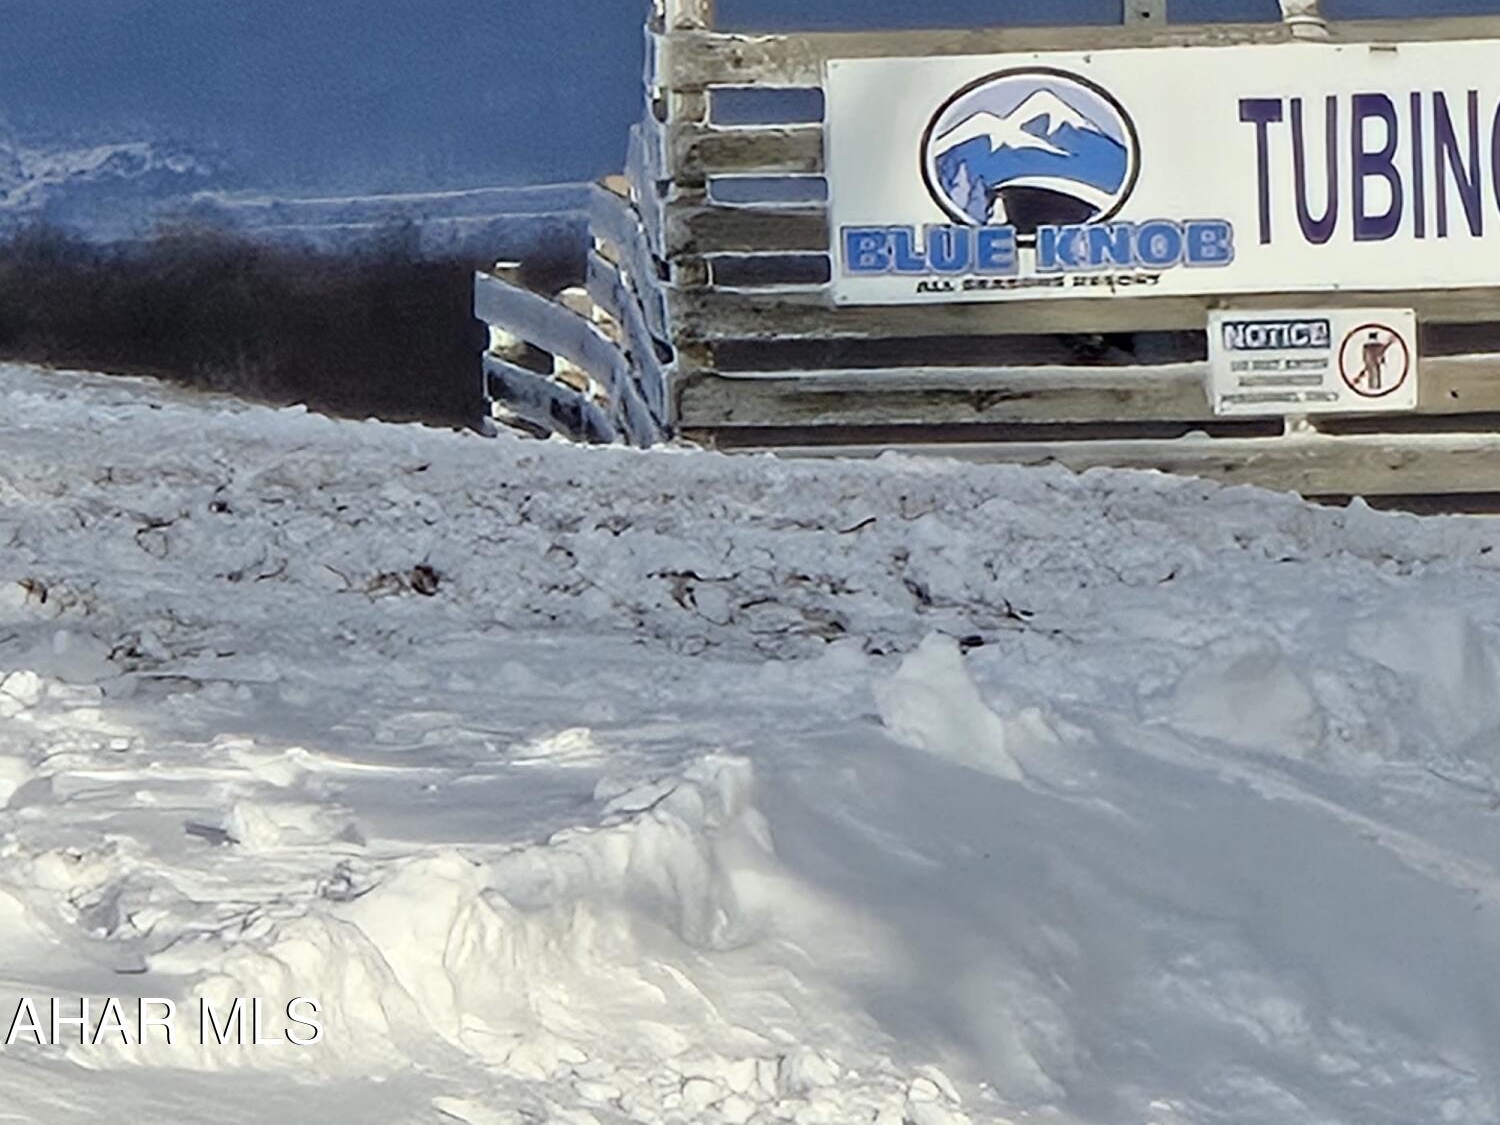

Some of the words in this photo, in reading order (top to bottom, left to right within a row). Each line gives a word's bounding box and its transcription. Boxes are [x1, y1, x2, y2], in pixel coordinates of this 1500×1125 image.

[840, 225, 1018, 276] BLUE
[1035, 218, 1235, 272] KNOB
[1224, 323, 1328, 348] NOTICE
